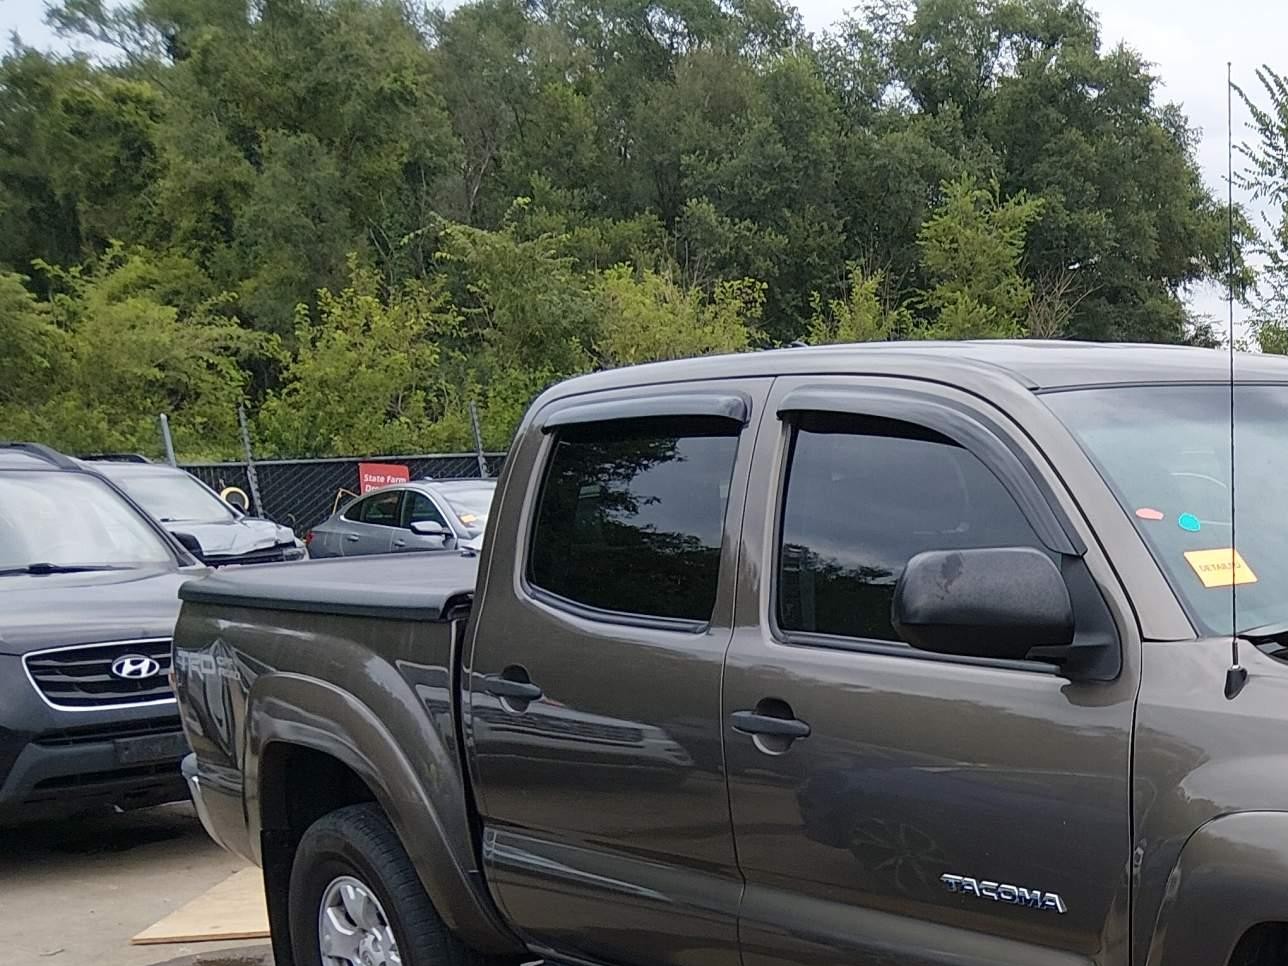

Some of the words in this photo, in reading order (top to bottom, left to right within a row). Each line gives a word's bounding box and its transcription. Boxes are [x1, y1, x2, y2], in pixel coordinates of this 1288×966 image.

[363, 473, 386, 483] State
[386, 475, 407, 484] Farm
[940, 873, 1067, 913] TACOMA
